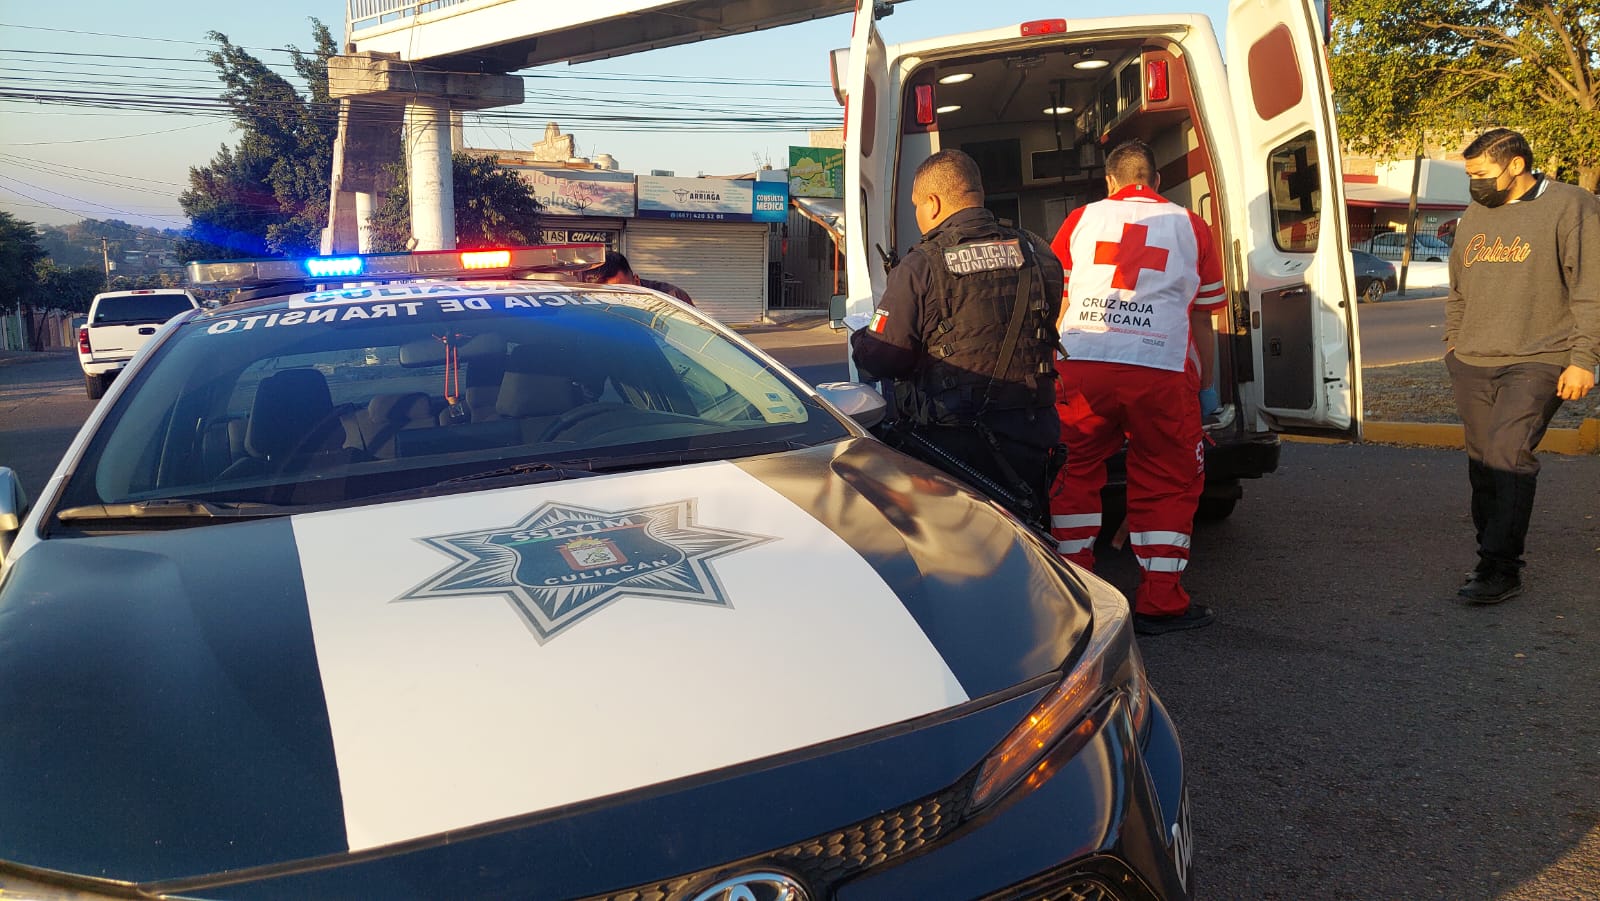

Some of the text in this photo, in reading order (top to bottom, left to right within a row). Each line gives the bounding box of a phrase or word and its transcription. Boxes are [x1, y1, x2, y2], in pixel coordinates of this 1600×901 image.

[756, 194, 784, 202] CONSULTA
[571, 231, 607, 242] COPIAS
[1464, 233, 1531, 267] Culichi
[948, 257, 1023, 273] MUNICIPAL
[304, 281, 571, 304] CULIAC
[1082, 297, 1154, 315] CRUZ ROJA
[1079, 311, 1152, 328] MEXICANA
[511, 517, 634, 542] SSPYTM
[544, 560, 669, 585] CULIACAN
